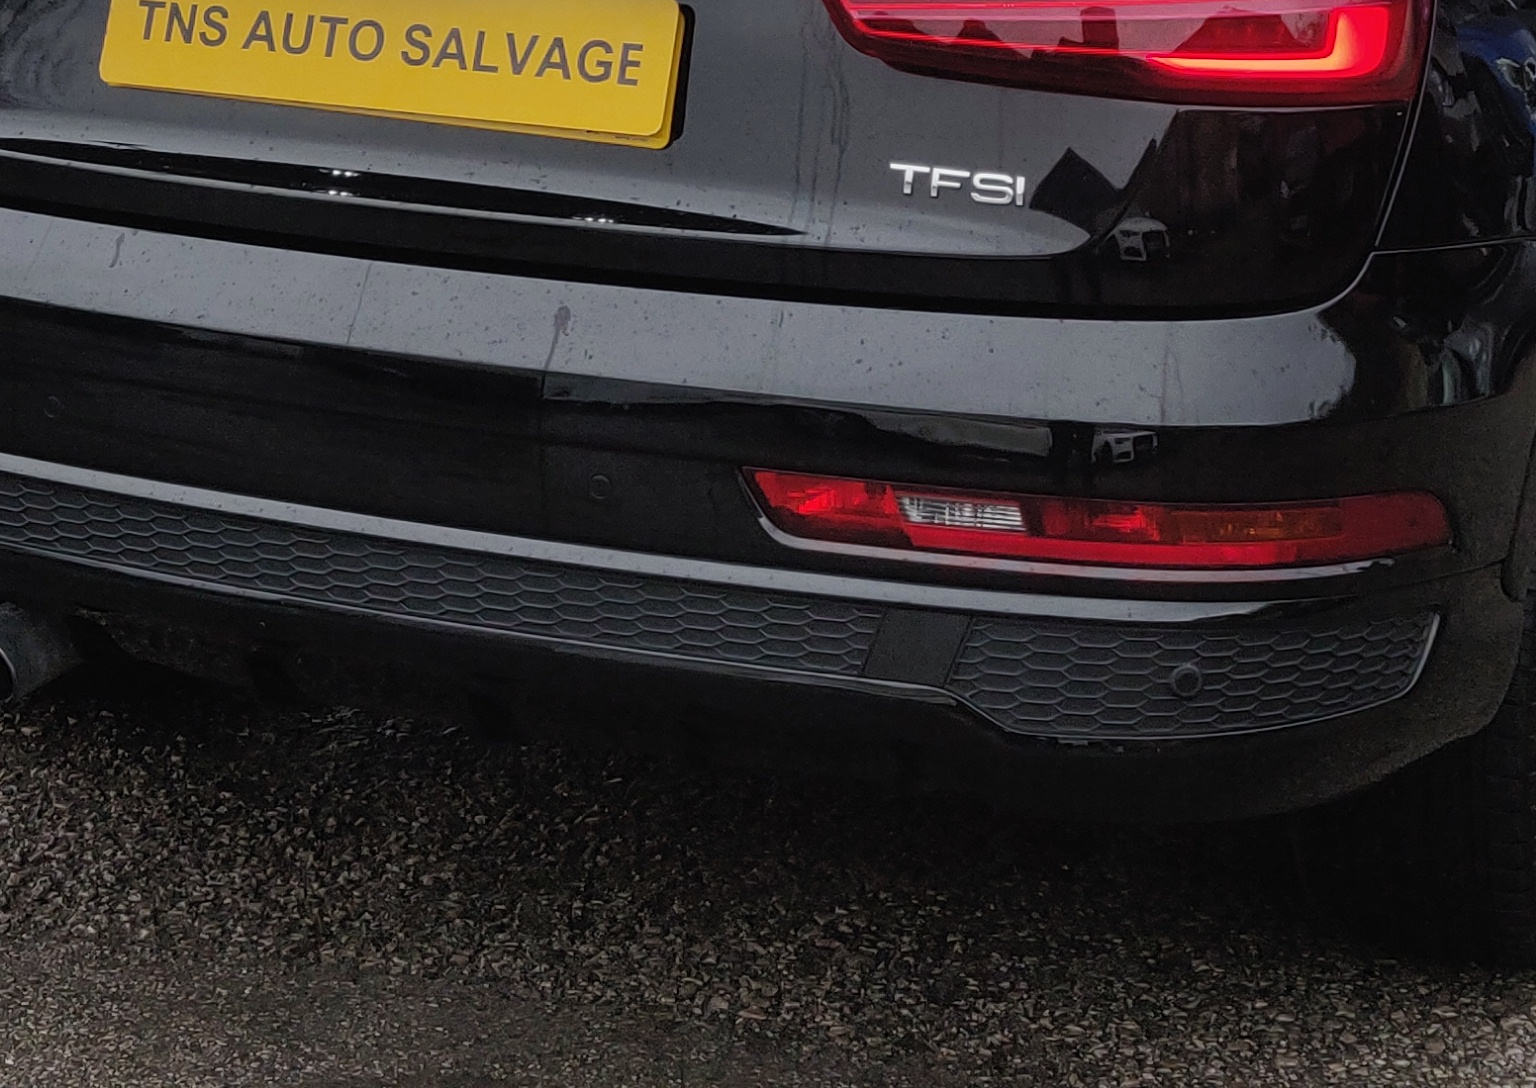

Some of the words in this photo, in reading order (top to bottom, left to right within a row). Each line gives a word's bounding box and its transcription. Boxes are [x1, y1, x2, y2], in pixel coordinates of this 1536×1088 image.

[138, 0, 229, 47] TNS
[242, 9, 385, 61] AUTO
[400, 23, 644, 87] SALVAGE
[889, 162, 1026, 206] TFSI
